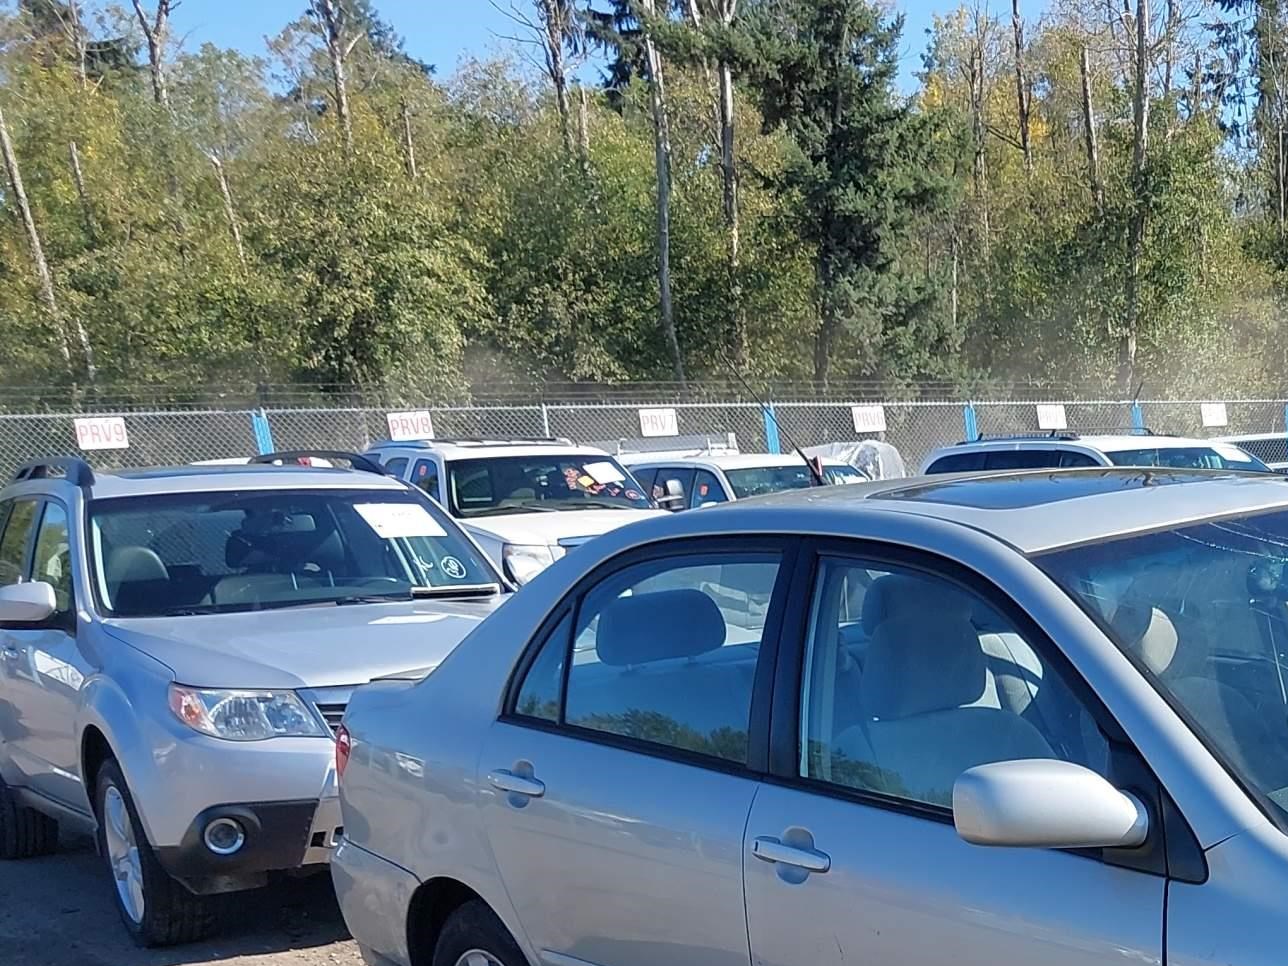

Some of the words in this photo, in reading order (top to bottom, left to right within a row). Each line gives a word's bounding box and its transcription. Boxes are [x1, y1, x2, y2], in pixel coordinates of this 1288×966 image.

[77, 422, 125, 444] PRV9
[389, 414, 432, 437] PRV8
[642, 413, 676, 432] PRV7
